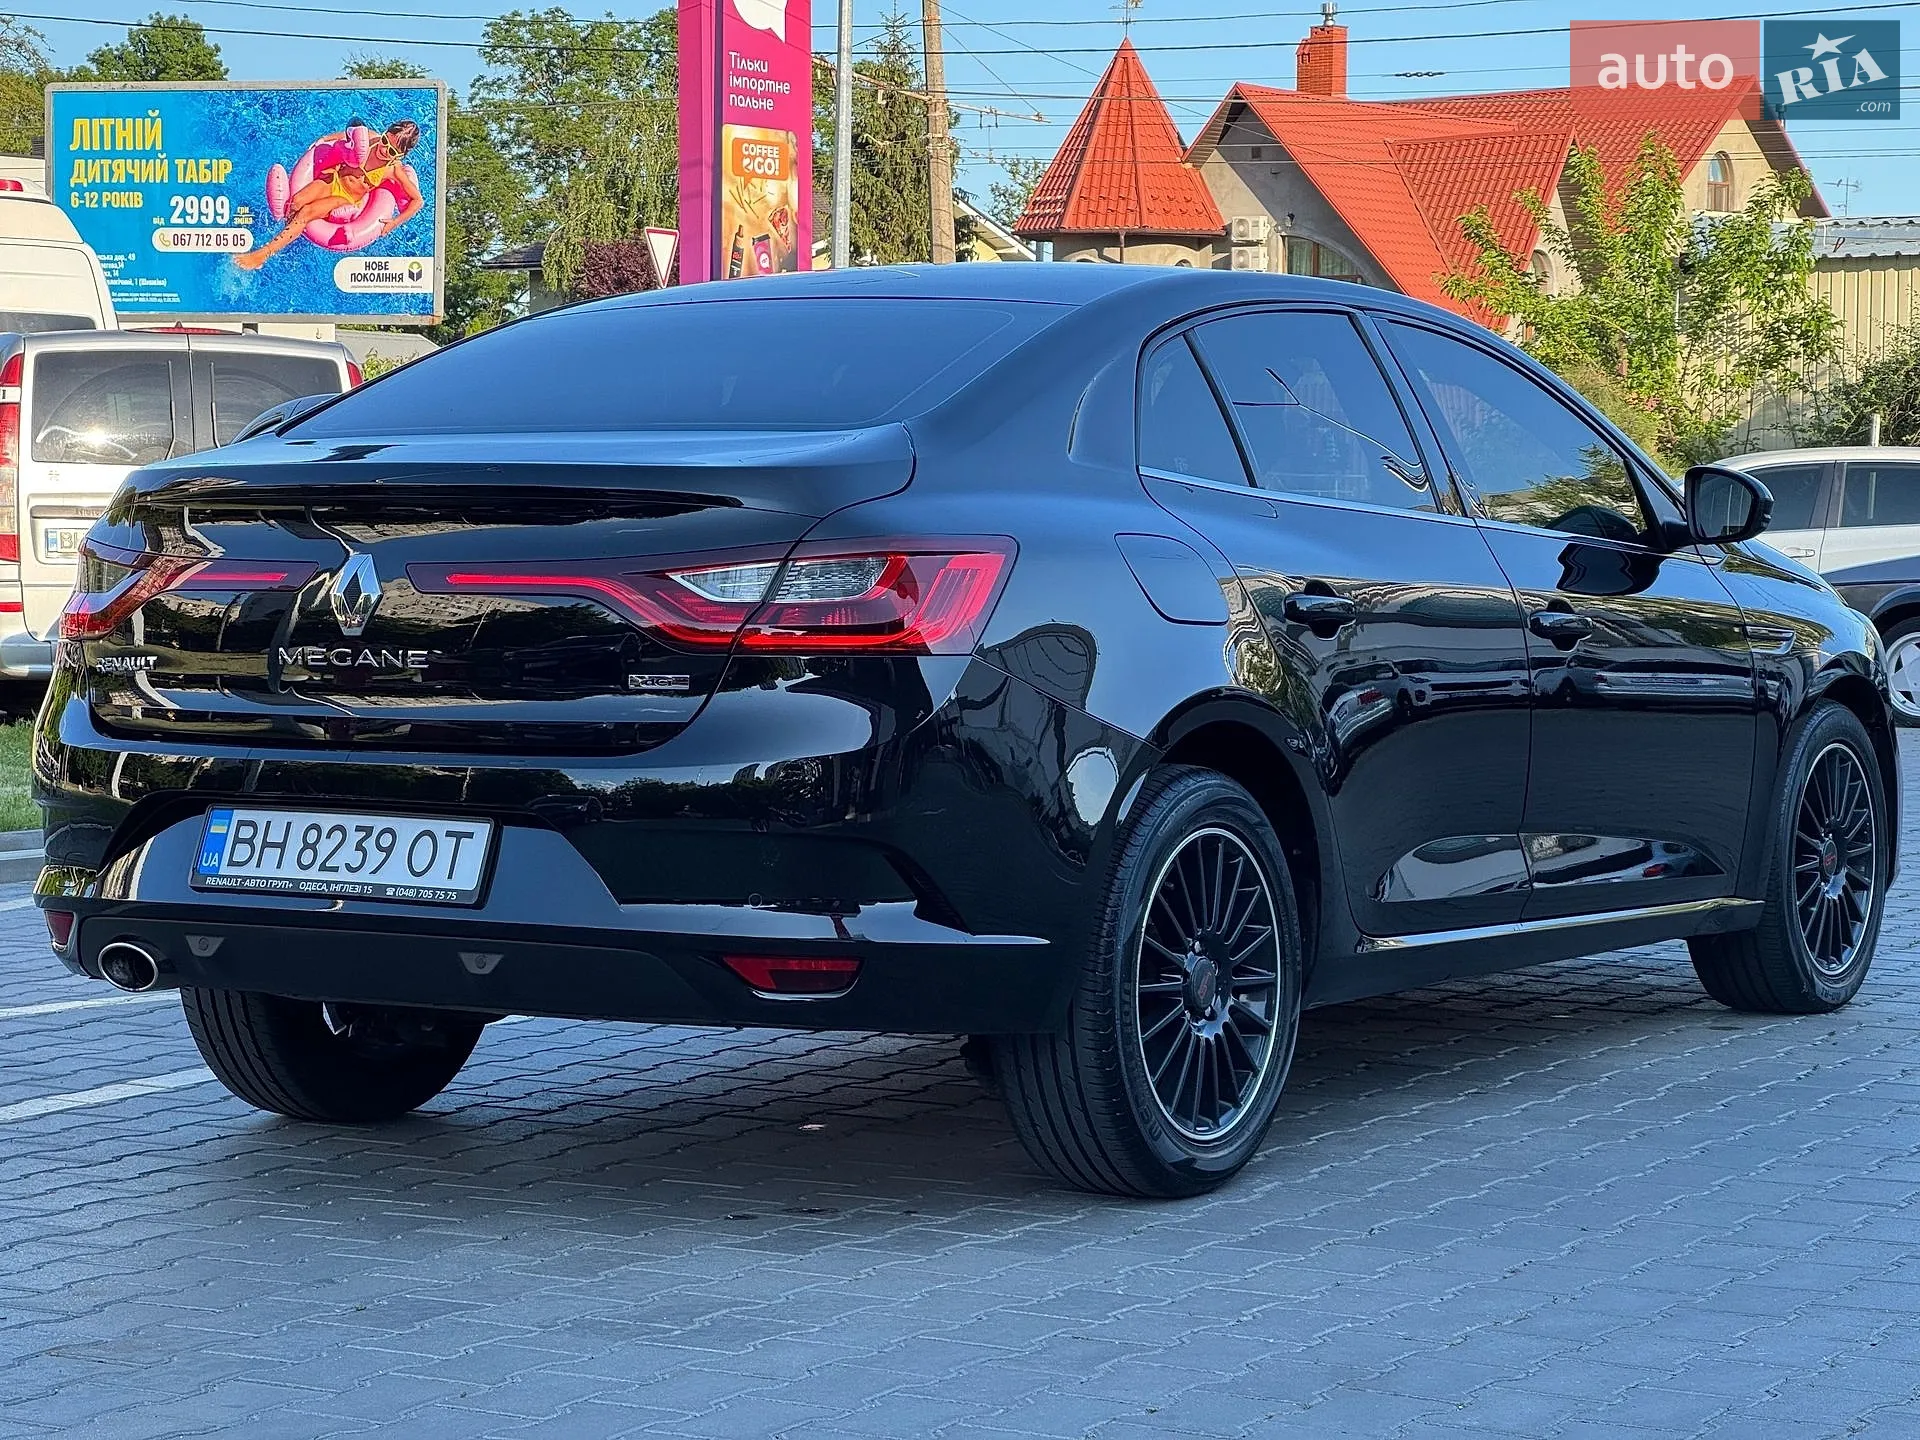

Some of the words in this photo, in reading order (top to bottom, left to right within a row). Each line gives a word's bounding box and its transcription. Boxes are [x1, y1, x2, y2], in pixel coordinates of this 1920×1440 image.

[729, 51, 768, 73] Тільки
[729, 71, 791, 95] імпортне
[729, 93, 775, 111] пальне
[69, 109, 162, 151] ЛІТНІЙ
[742, 143, 780, 159] COFFEE
[70, 152, 169, 187] ДИТЯЧИЙ
[174, 158, 233, 184] ТАБІР
[70, 191, 99, 208] 6-12
[102, 191, 144, 208] РОКІВ
[169, 195, 230, 224] 2999
[172, 233, 192, 247] 067
[194, 233, 212, 247] 712
[215, 233, 229, 247] 05
[232, 233, 246, 247] 05
[364, 261, 390, 271] НОВЕ
[350, 272, 404, 283] ПОКОЛІННЯ
[96, 656, 158, 672] RENAULT
[278, 647, 430, 669] MEGANE
[226, 819, 293, 869] BH
[296, 823, 398, 875] 8239
[407, 829, 475, 880] OT
[202, 851, 220, 869] UA
[299, 881, 329, 892] ОДЕСА,
[330, 883, 361, 893] ІНГЛЕЗІ
[363, 886, 373, 894] 15
[395, 888, 417, 898] (048)
[418, 889, 433, 899] 705
[434, 891, 445, 899] 75
[446, 891, 457, 900] 75
